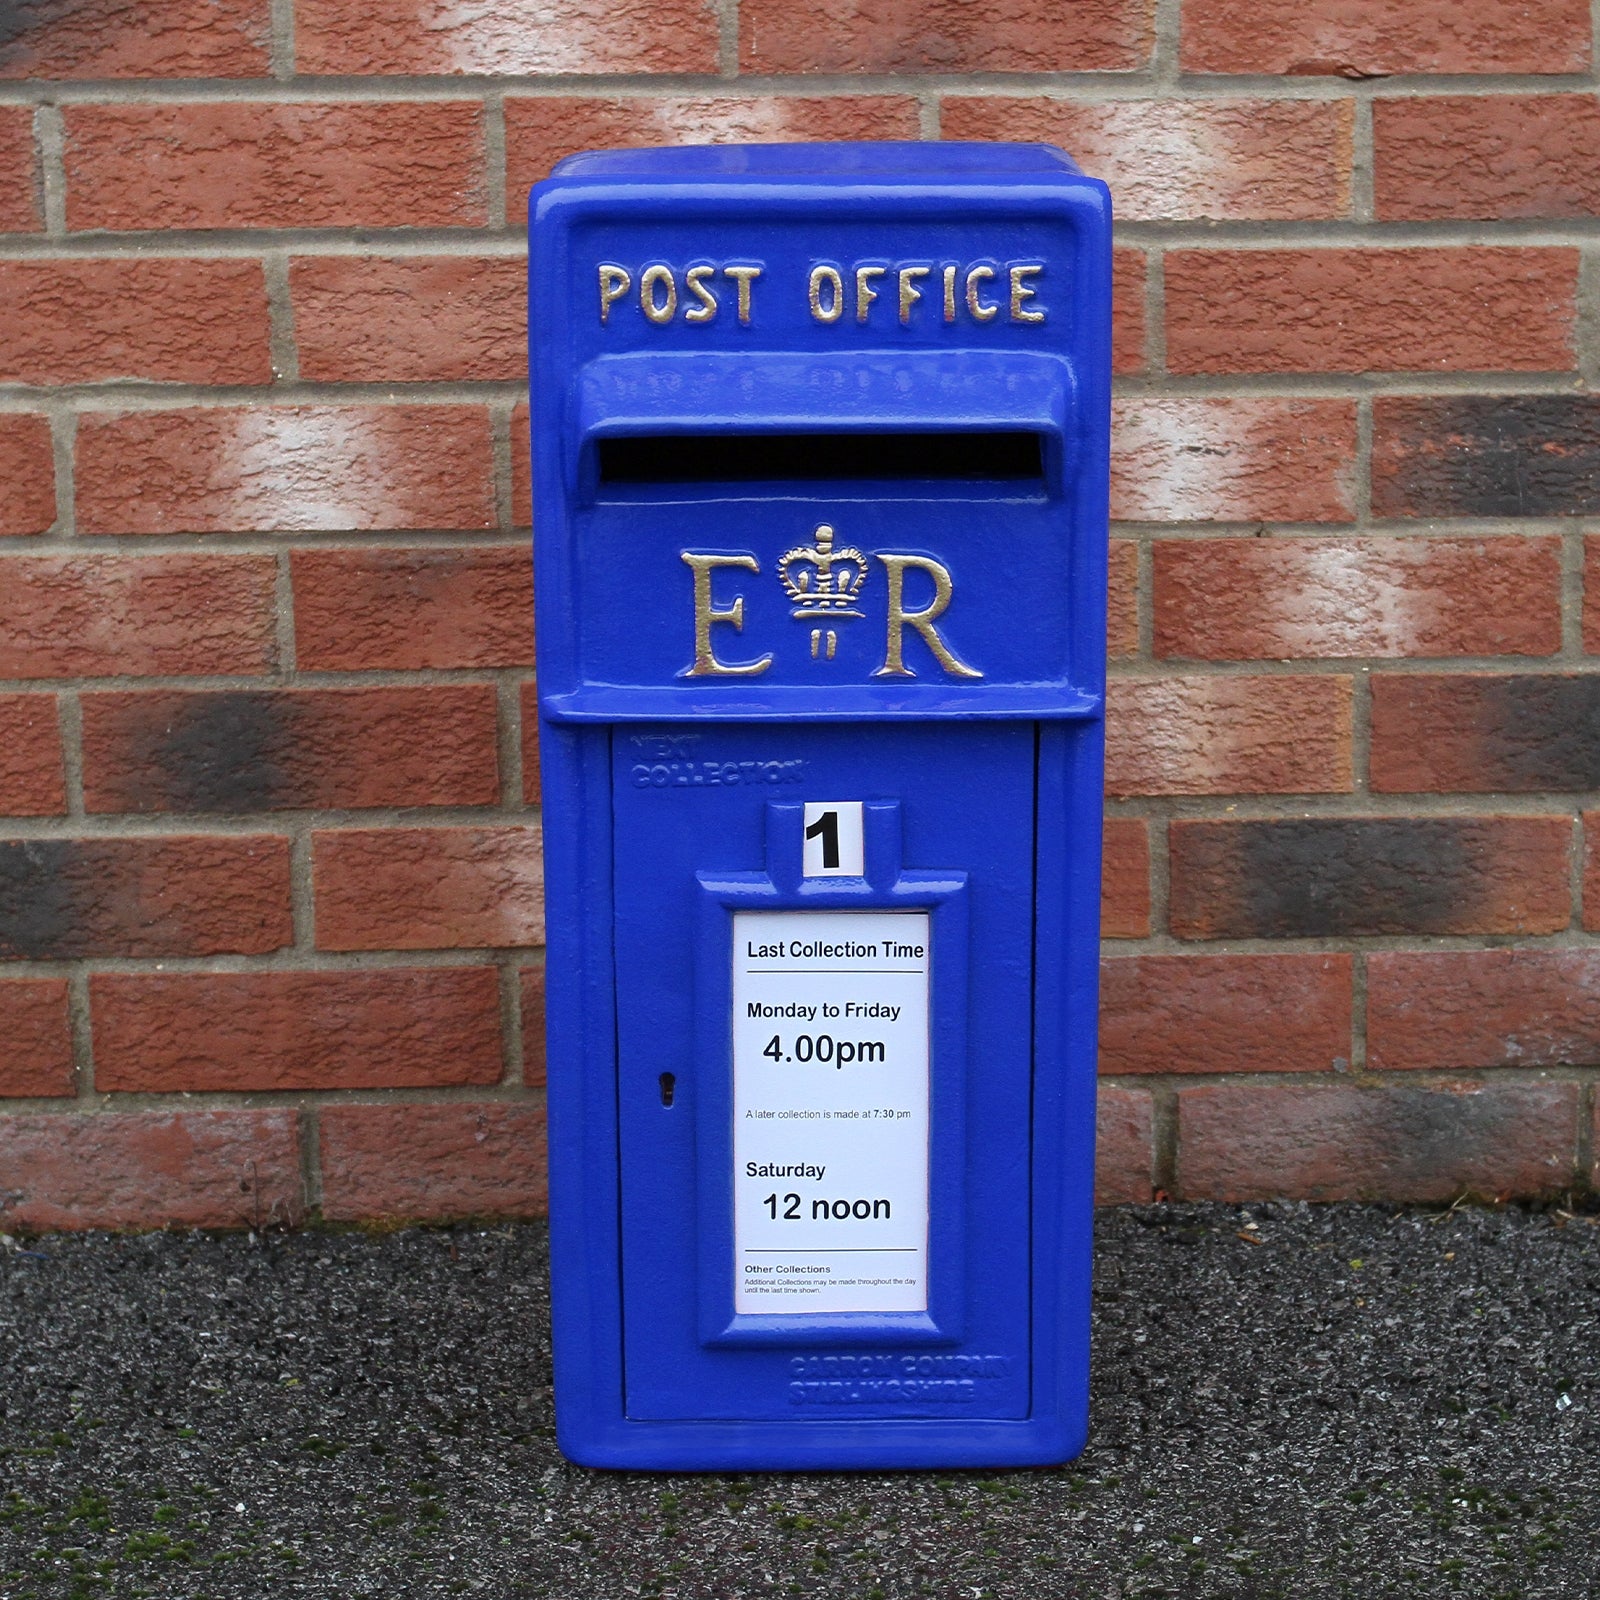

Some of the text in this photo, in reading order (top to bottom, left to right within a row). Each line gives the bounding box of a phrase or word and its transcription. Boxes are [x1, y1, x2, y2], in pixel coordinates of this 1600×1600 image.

[598, 264, 1046, 324] POST OFFICE
[680, 549, 984, 679] E R
[630, 759, 808, 789] COLLECTION
[805, 811, 840, 869] 1
[747, 940, 924, 959] Last Collection Time
[747, 1002, 901, 1022] Monday to Friday
[762, 1034, 885, 1070] 4.00pm
[745, 1108, 912, 1121] A later collection is made at 7:30 pm
[745, 1161, 826, 1182] Saturday
[763, 1192, 891, 1221] 12 noon
[744, 1264, 831, 1274] Other Collections
[744, 1278, 776, 1286] Additional
[777, 1277, 813, 1286] Collections
[813, 1279, 828, 1287] may
[828, 1278, 838, 1286] be
[838, 1278, 857, 1286] made
[857, 1278, 892, 1287] throughout
[904, 1278, 917, 1287] day
[744, 1286, 759, 1294] until
